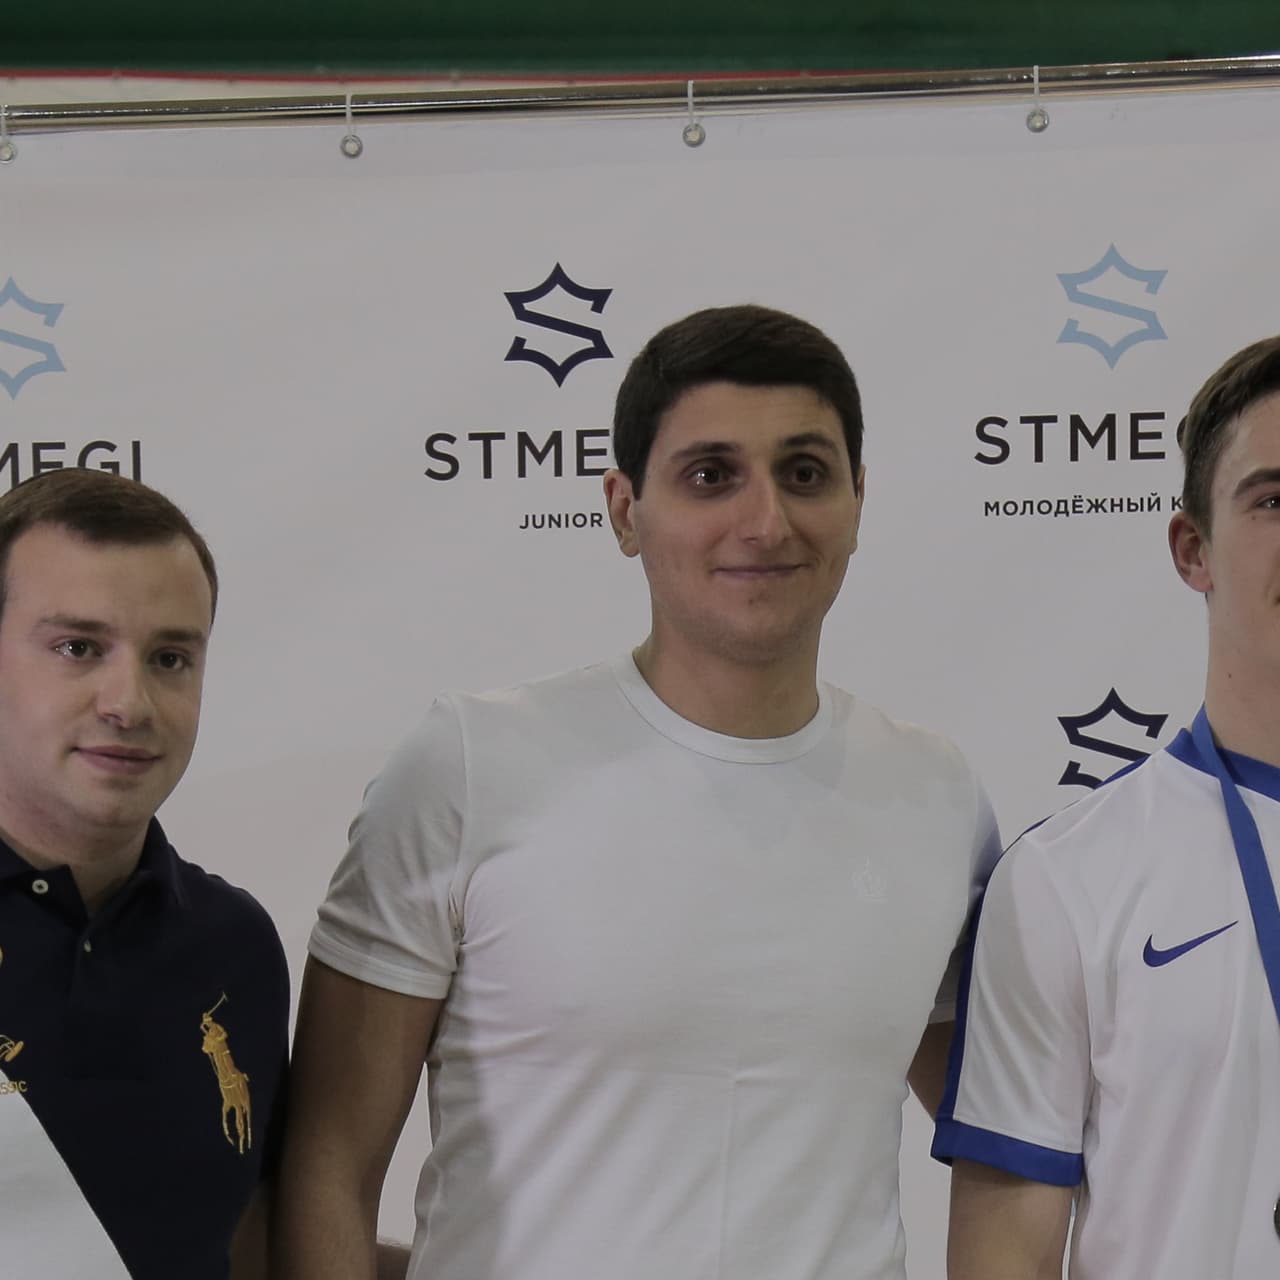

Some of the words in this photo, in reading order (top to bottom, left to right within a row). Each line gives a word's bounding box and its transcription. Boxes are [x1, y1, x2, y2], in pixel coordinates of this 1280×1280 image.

[424, 429, 610, 481] STME
[974, 411, 1186, 465] STME
[519, 513, 603, 530] JUNIOR
[984, 493, 1162, 517] МОЛОДЁЖНЫЙ
